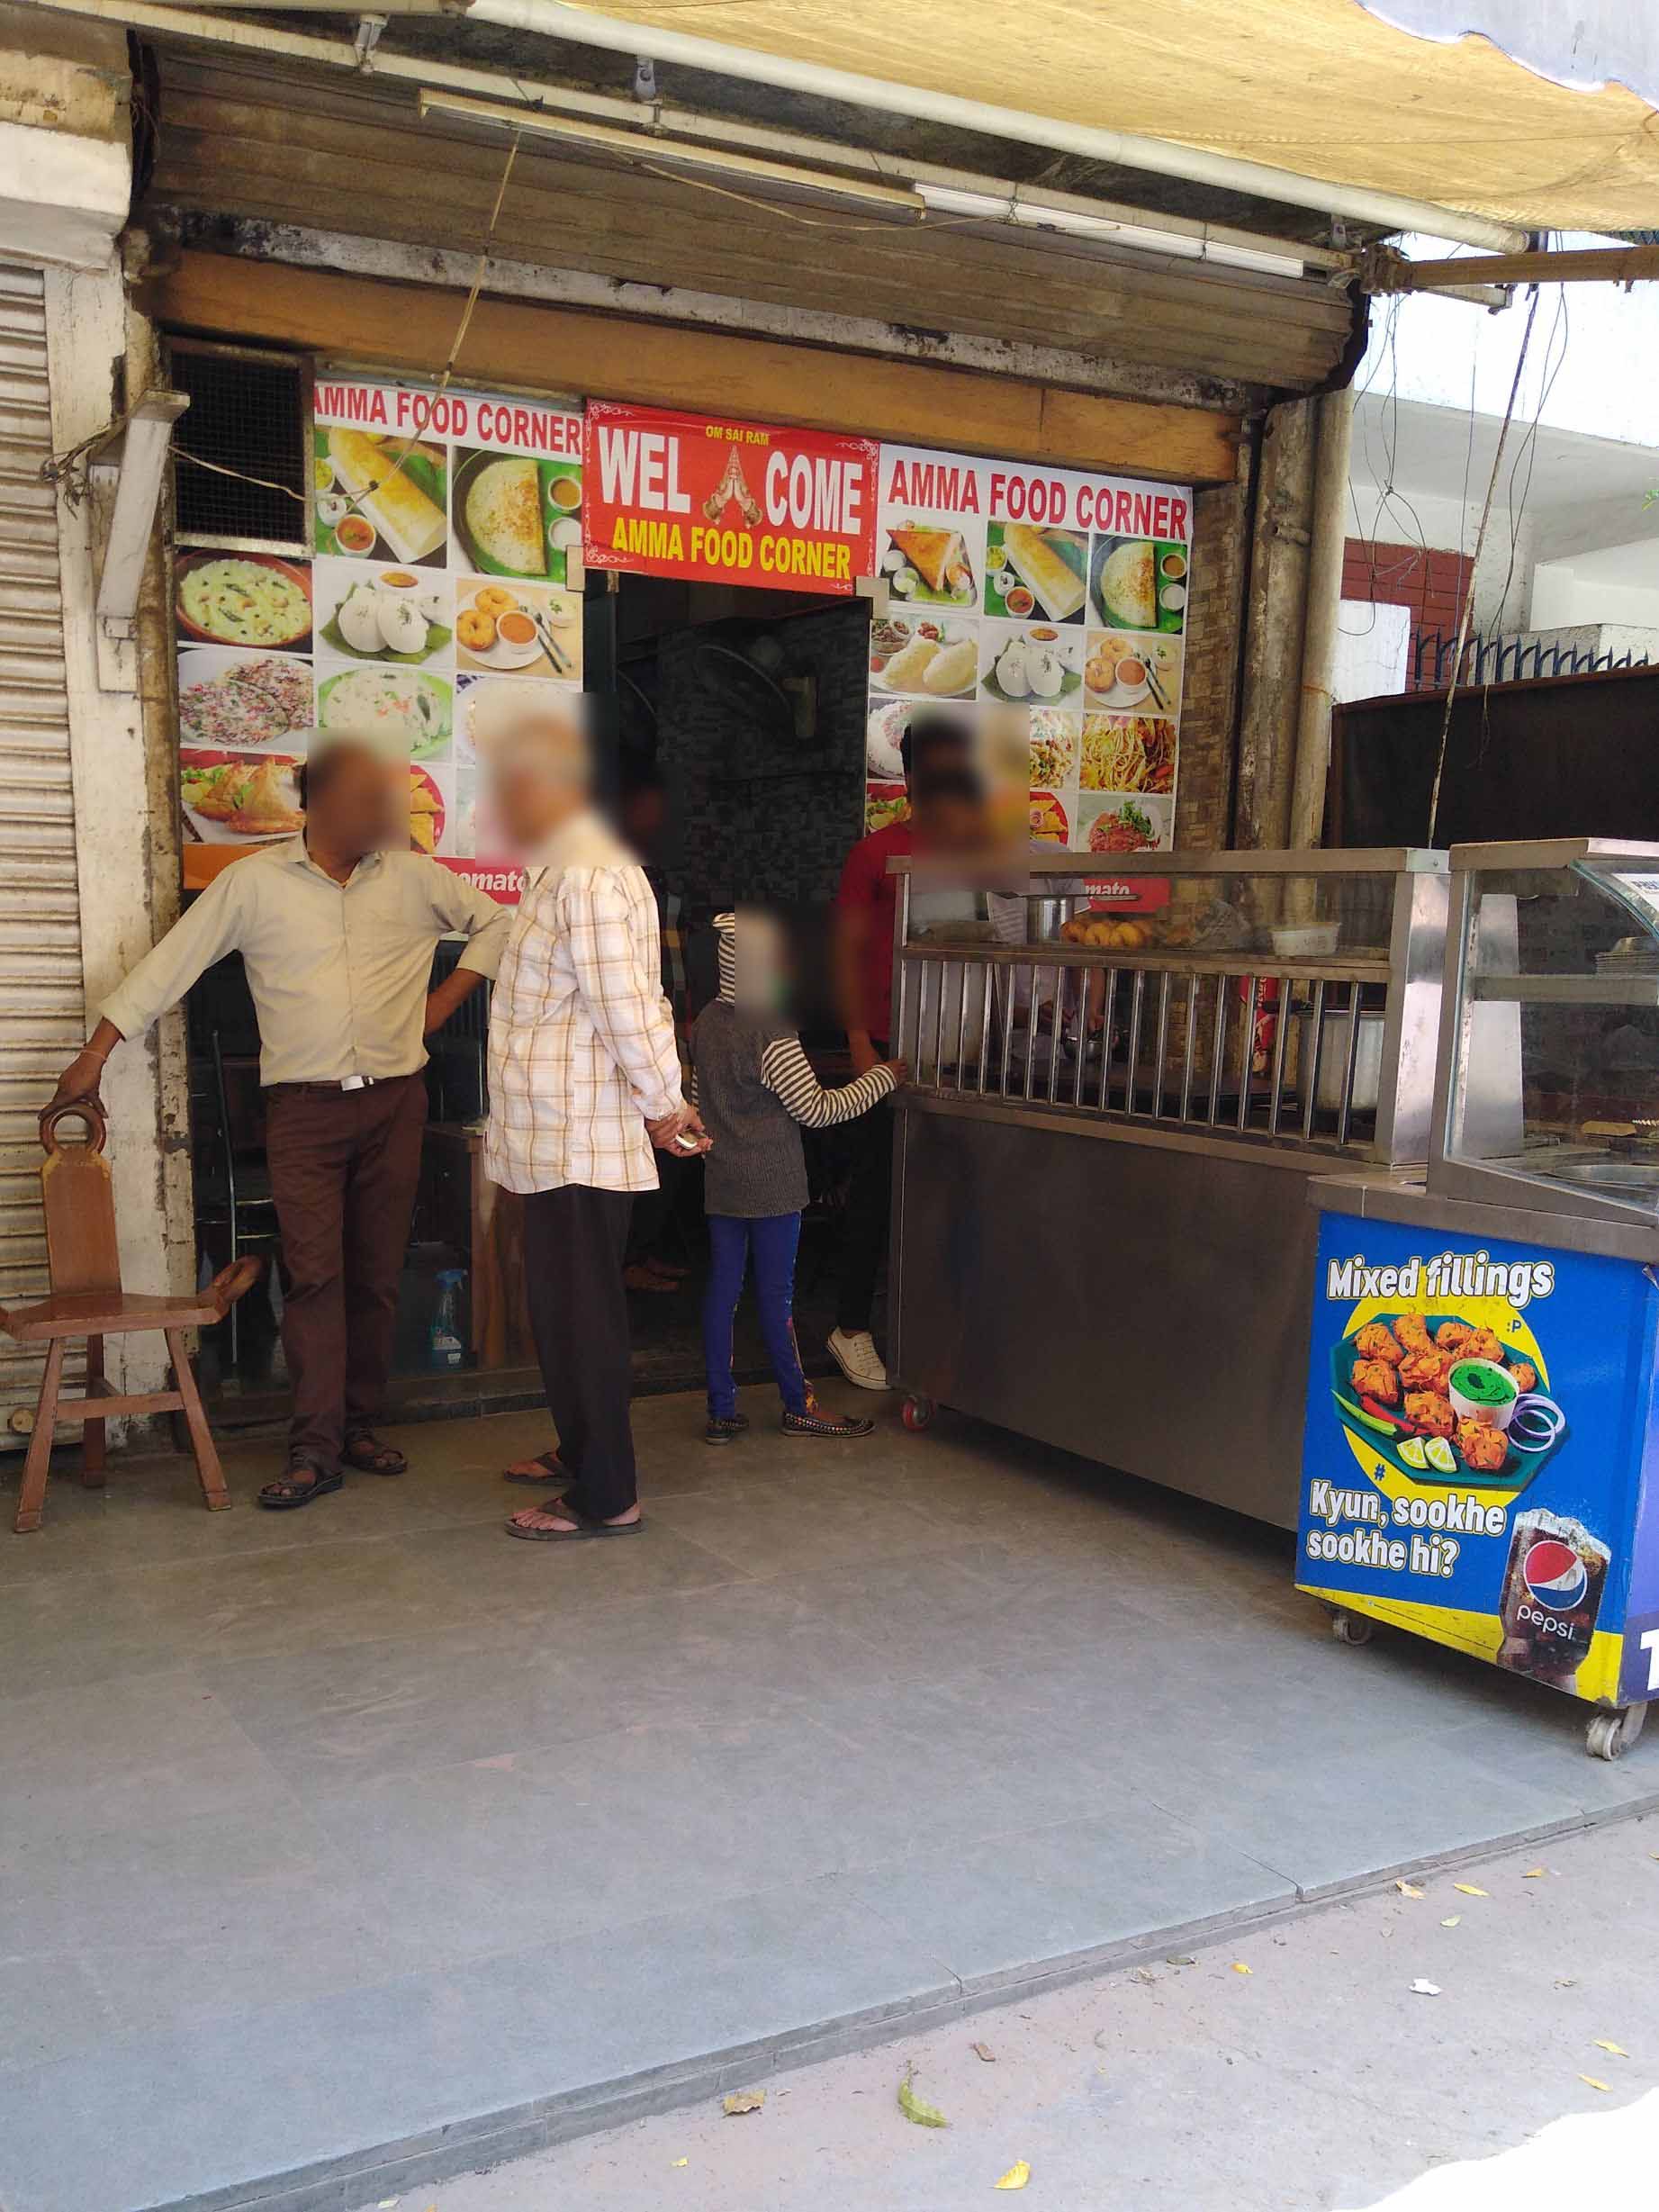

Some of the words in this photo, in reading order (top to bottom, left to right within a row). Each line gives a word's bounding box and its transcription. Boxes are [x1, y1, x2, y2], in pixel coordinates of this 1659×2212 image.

[315, 385, 387, 425] AMMA
[397, 391, 468, 436] FOOD
[477, 402, 582, 456] CORNER
[705, 425, 724, 439] OM
[726, 428, 744, 442] SAI
[746, 430, 770, 447] RAM
[598, 426, 690, 514] WEL
[765, 450, 863, 535] COME
[888, 460, 979, 514] AMMA
[989, 473, 1066, 524] FOOD
[1076, 485, 1187, 540] CORNER
[612, 517, 684, 562] AMMA
[690, 526, 753, 568] FOOD
[760, 535, 851, 581] CORNER
[1328, 1255, 1421, 1299] Mixed
[1426, 1251, 1555, 1309] fillings
[1311, 1479, 1388, 1528] Kyun,
[1393, 1493, 1507, 1537] sookhe
[1306, 1528, 1407, 1570] sookhe
[1409, 1533, 1460, 1578] hi?
[1517, 1604, 1573, 1639] pepsi
